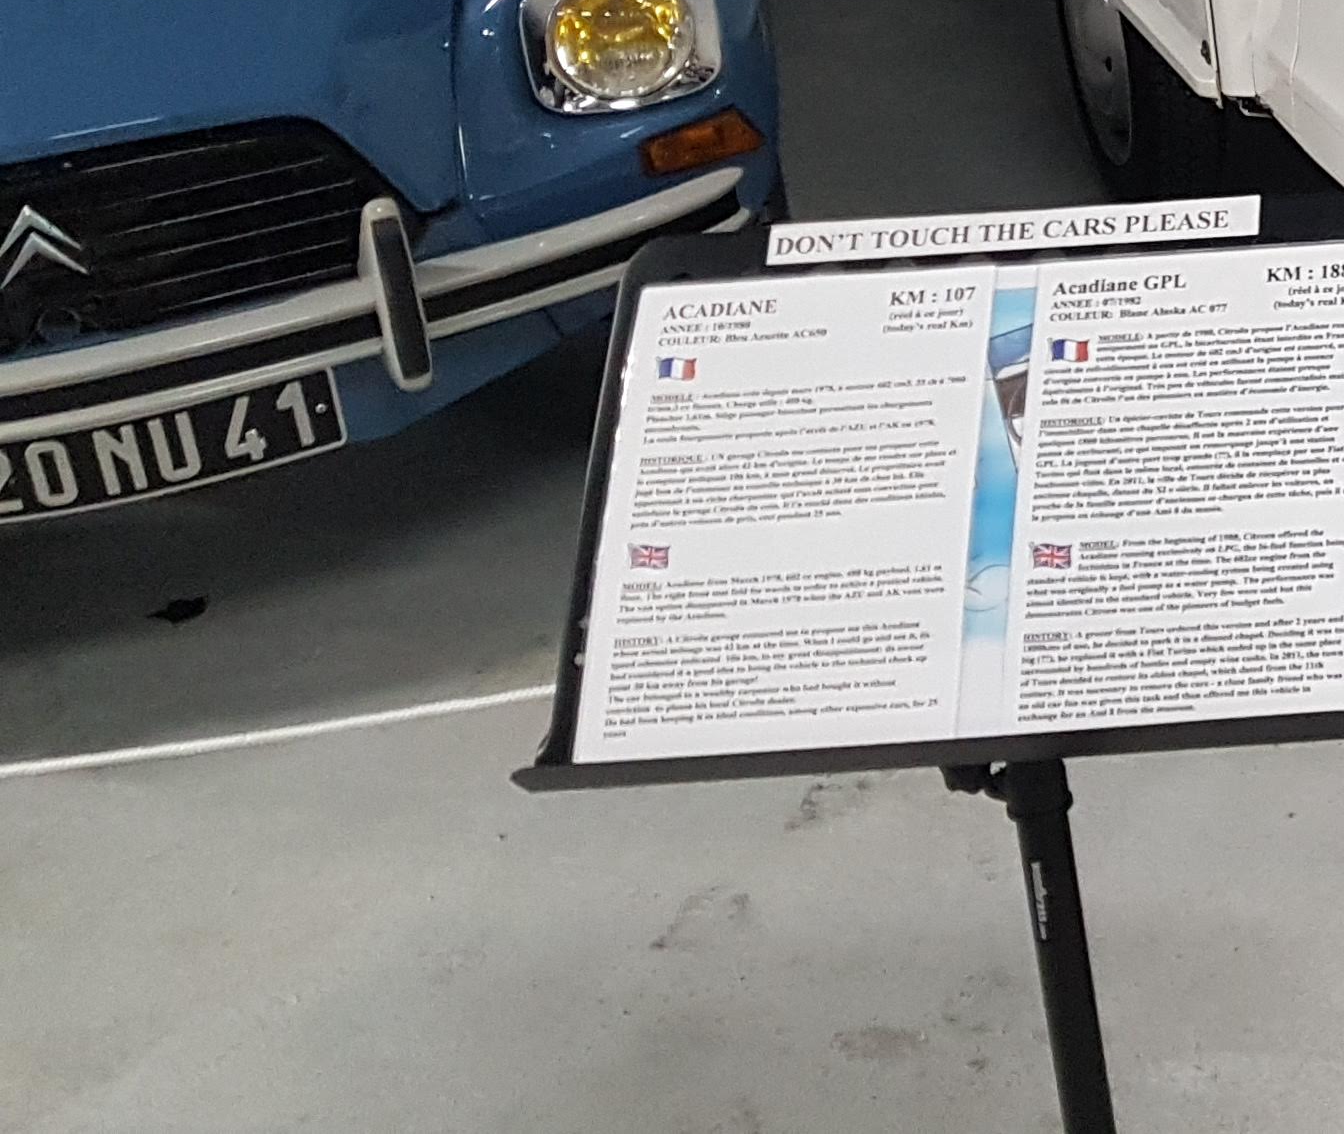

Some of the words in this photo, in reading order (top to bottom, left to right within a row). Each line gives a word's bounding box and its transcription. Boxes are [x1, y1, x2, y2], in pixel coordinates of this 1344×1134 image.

[776, 232, 864, 256] DON'T
[871, 225, 970, 249] TOUCH
[979, 221, 1034, 242] THE
[1044, 216, 1117, 239] CARS
[1125, 210, 1229, 234] PLEASE
[1266, 265, 1302, 283] KM
[1051, 279, 1139, 296] Acadiane
[1142, 273, 1187, 291] GPL
[1287, 285, 1312, 296] (réel
[1313, 284, 1321, 294] à
[1321, 286, 1334, 294] ce
[889, 289, 926, 306] KM
[944, 286, 976, 302] 107
[1272, 298, 1315, 309] (today's
[1316, 297, 1338, 307] real
[662, 299, 777, 320] ACADIANE
[1050, 298, 1094, 310] ANNEE
[1048, 309, 1114, 322] COULEUR:
[1118, 308, 1149, 318] Blanc
[1150, 306, 1187, 317] Alaska
[1188, 304, 1207, 314] AC
[1208, 302, 1228, 313] 077
[660, 323, 703, 334] ANNEE
[882, 323, 924, 333] (today's
[925, 321, 948, 330] real
[949, 319, 974, 329] Km)
[657, 334, 722, 347] COULEUR:
[724, 333, 749, 343] Bleu
[92, 411, 201, 496] NU
[225, 380, 315, 461] 41
[1147, 538, 1163, 546] the
[1309, 529, 1325, 537] the
[1242, 544, 1257, 552] the
[1214, 555, 1233, 564] The
[1311, 550, 1327, 558] the
